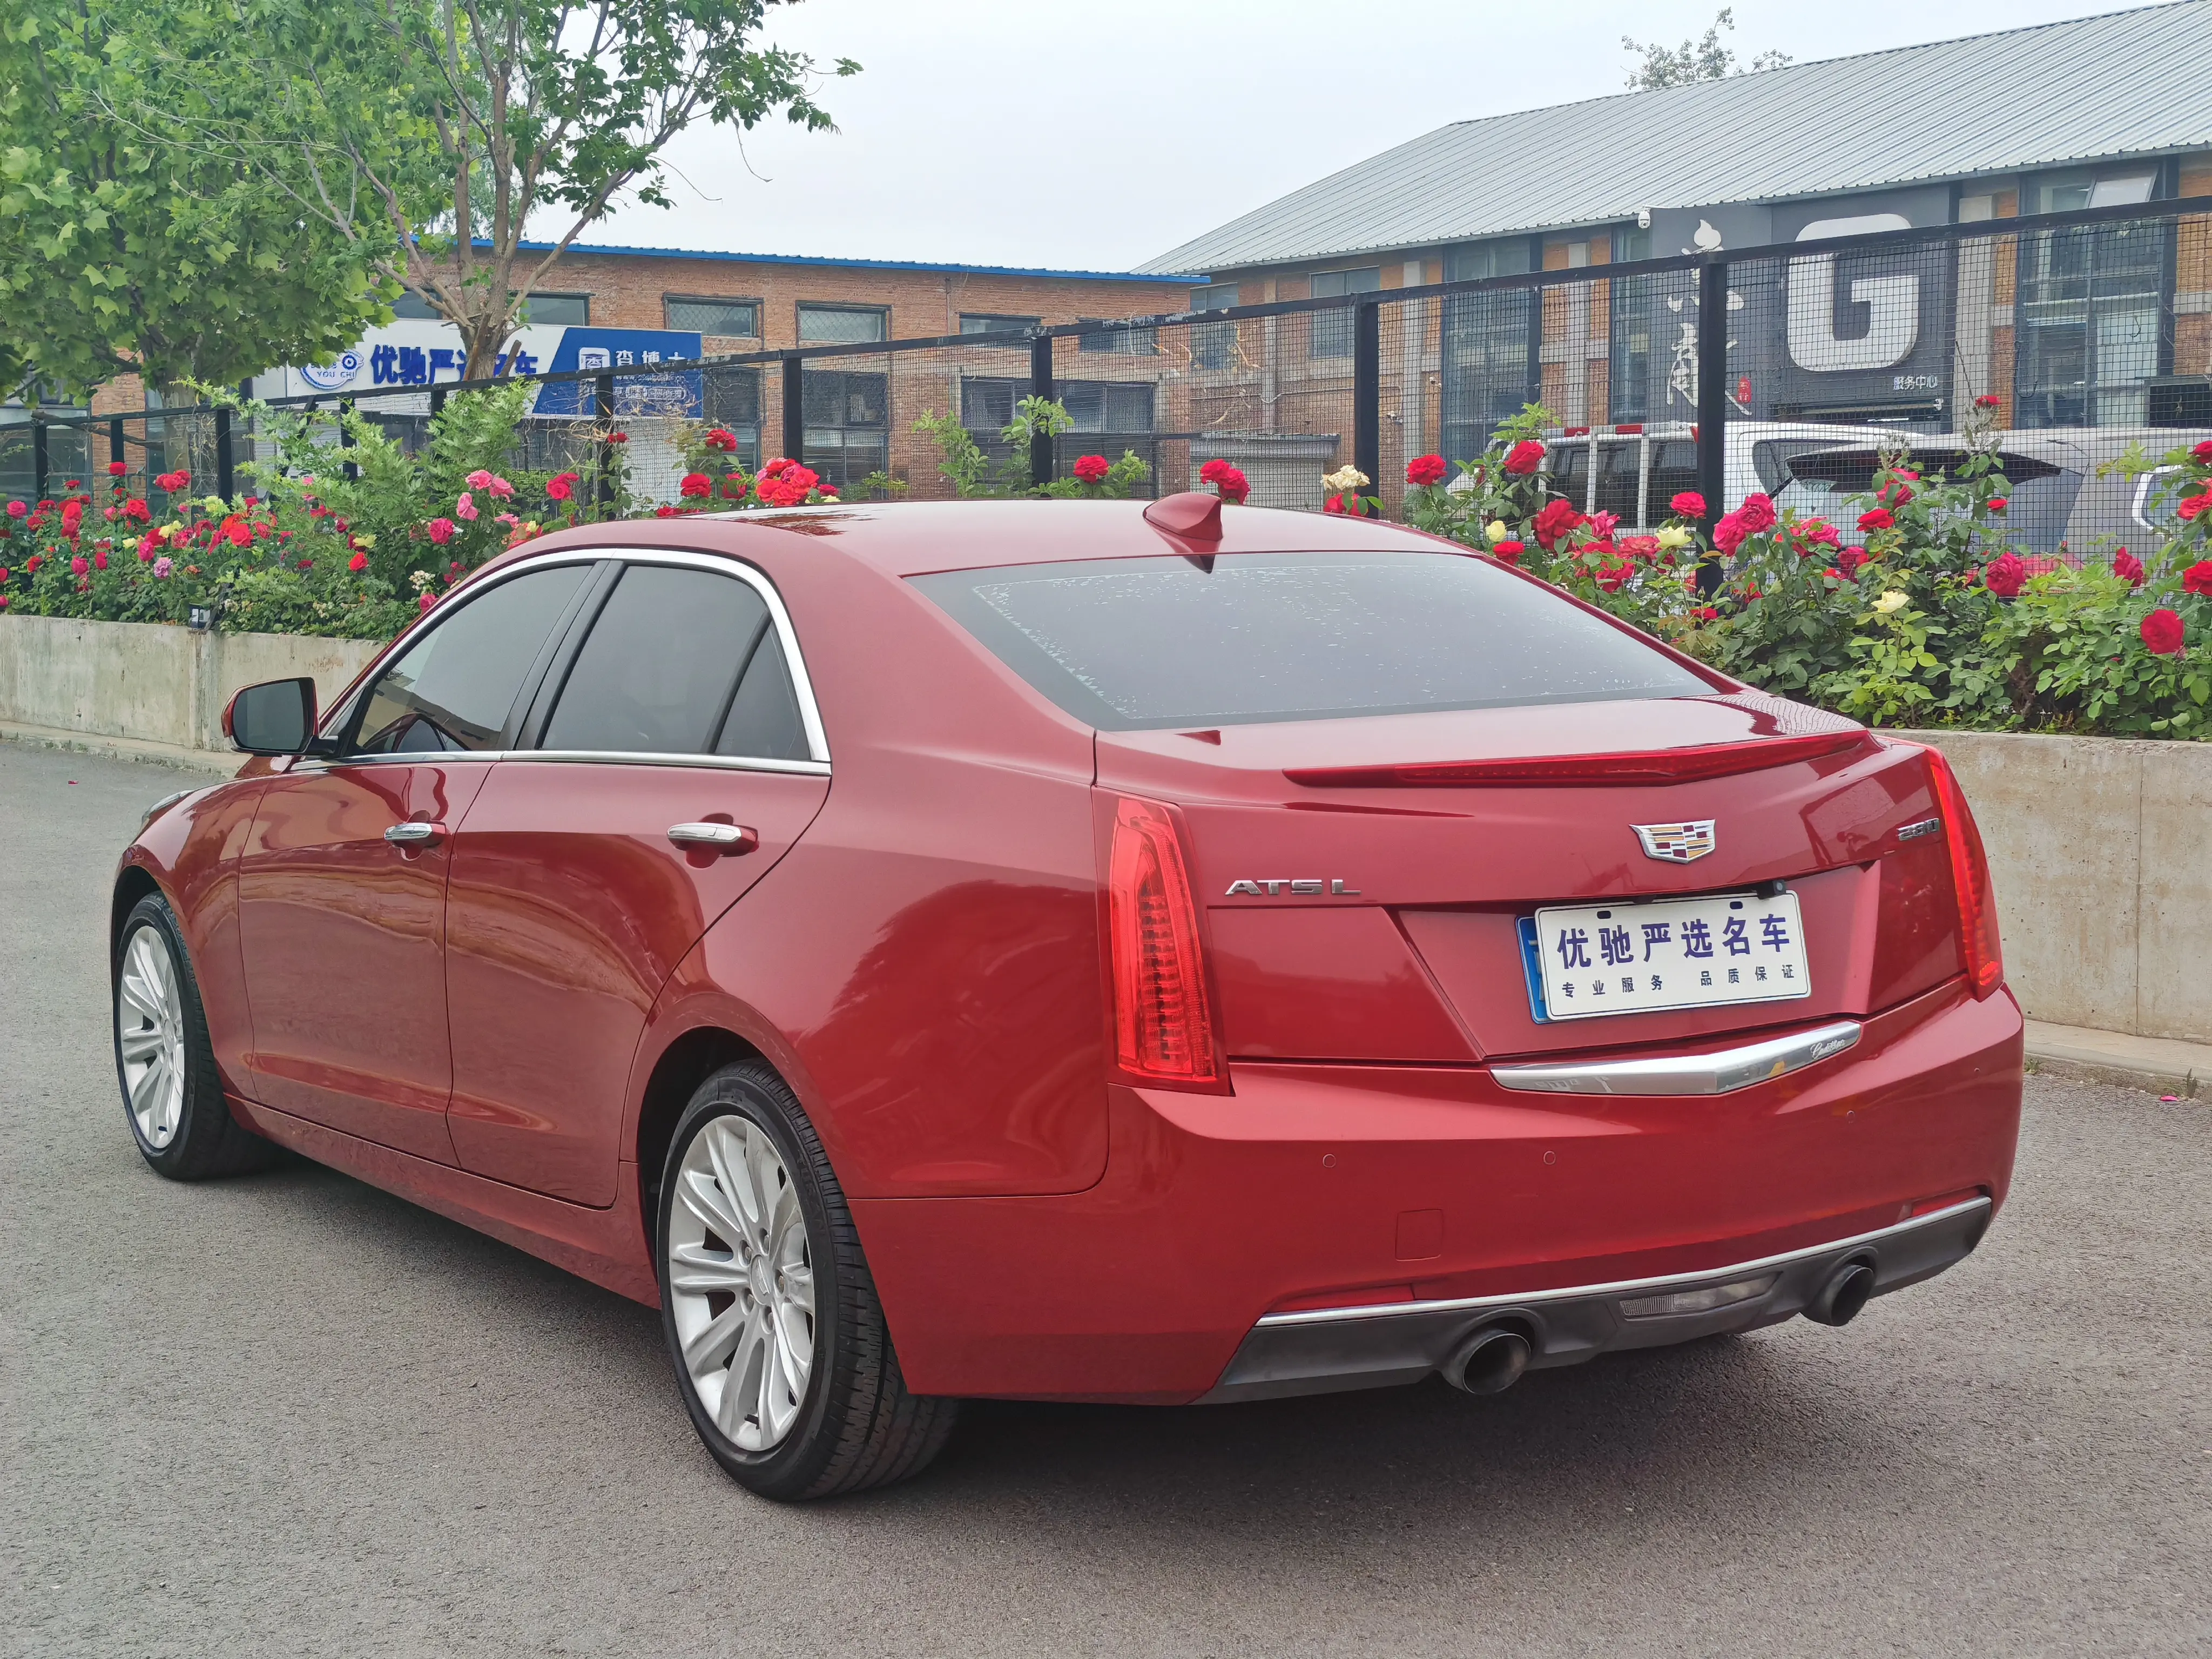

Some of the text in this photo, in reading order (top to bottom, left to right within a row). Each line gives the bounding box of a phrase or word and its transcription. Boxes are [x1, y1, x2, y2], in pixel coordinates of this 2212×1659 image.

[1788, 213, 1919, 372] G
[370, 345, 538, 384] 优驰严车
[1893, 375, 1938, 390] 服务中心
[1225, 879, 1361, 895] ATS L
[1557, 914, 1790, 969] 优驰严选名车
[1561, 963, 1795, 998] 专业服务 品质保证
